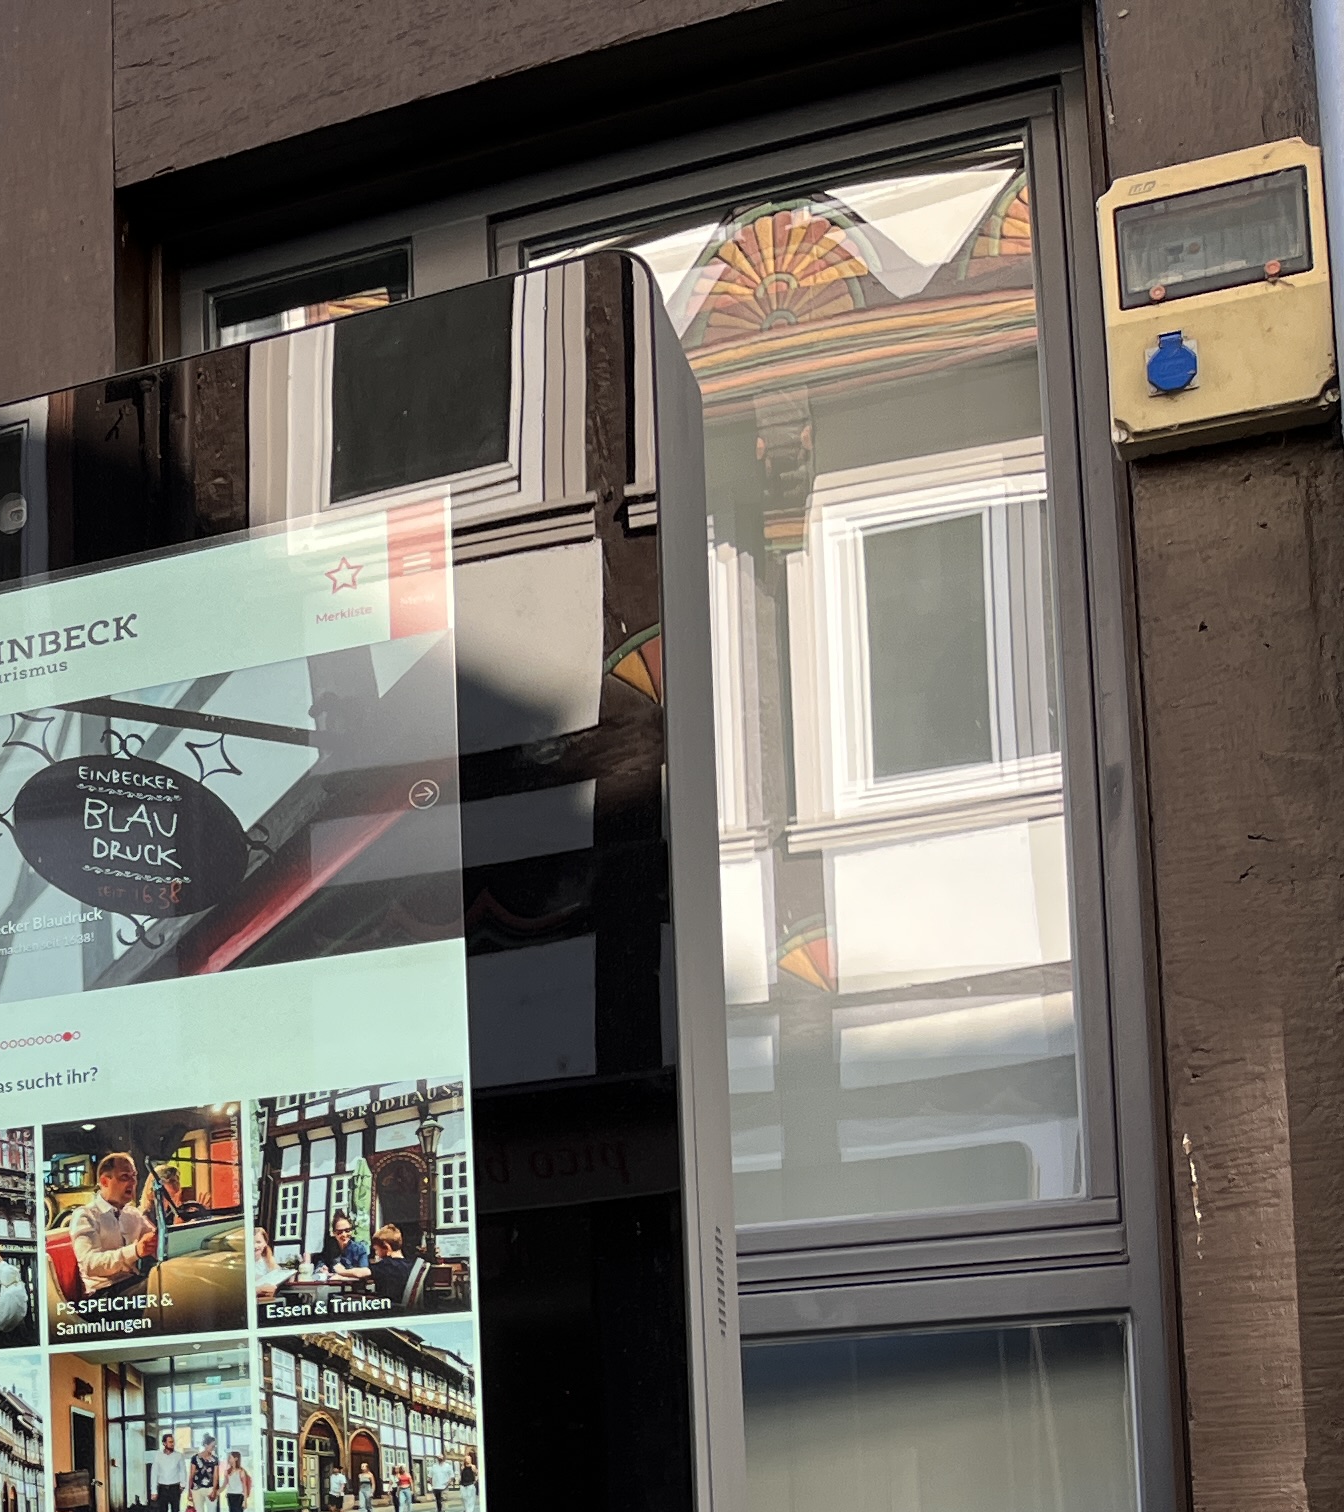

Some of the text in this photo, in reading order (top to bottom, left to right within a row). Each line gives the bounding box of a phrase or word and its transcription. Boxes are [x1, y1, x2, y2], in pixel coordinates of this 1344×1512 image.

[315, 603, 373, 627] Merkliste
[77, 765, 180, 792] EINBECKER
[82, 797, 179, 839] BLAU
[91, 837, 183, 870] DRUCK
[134, 878, 183, 910] 1638
[32, 907, 103, 930] Blaudruck
[41, 937, 61, 952] seit
[16, 1071, 64, 1093] sucht
[66, 1066, 99, 1085] ihr?
[55, 1293, 174, 1317] PS.SPEICHER &
[265, 1294, 392, 1320] Essen & Trinken
[55, 1315, 152, 1337] Sammlungen
